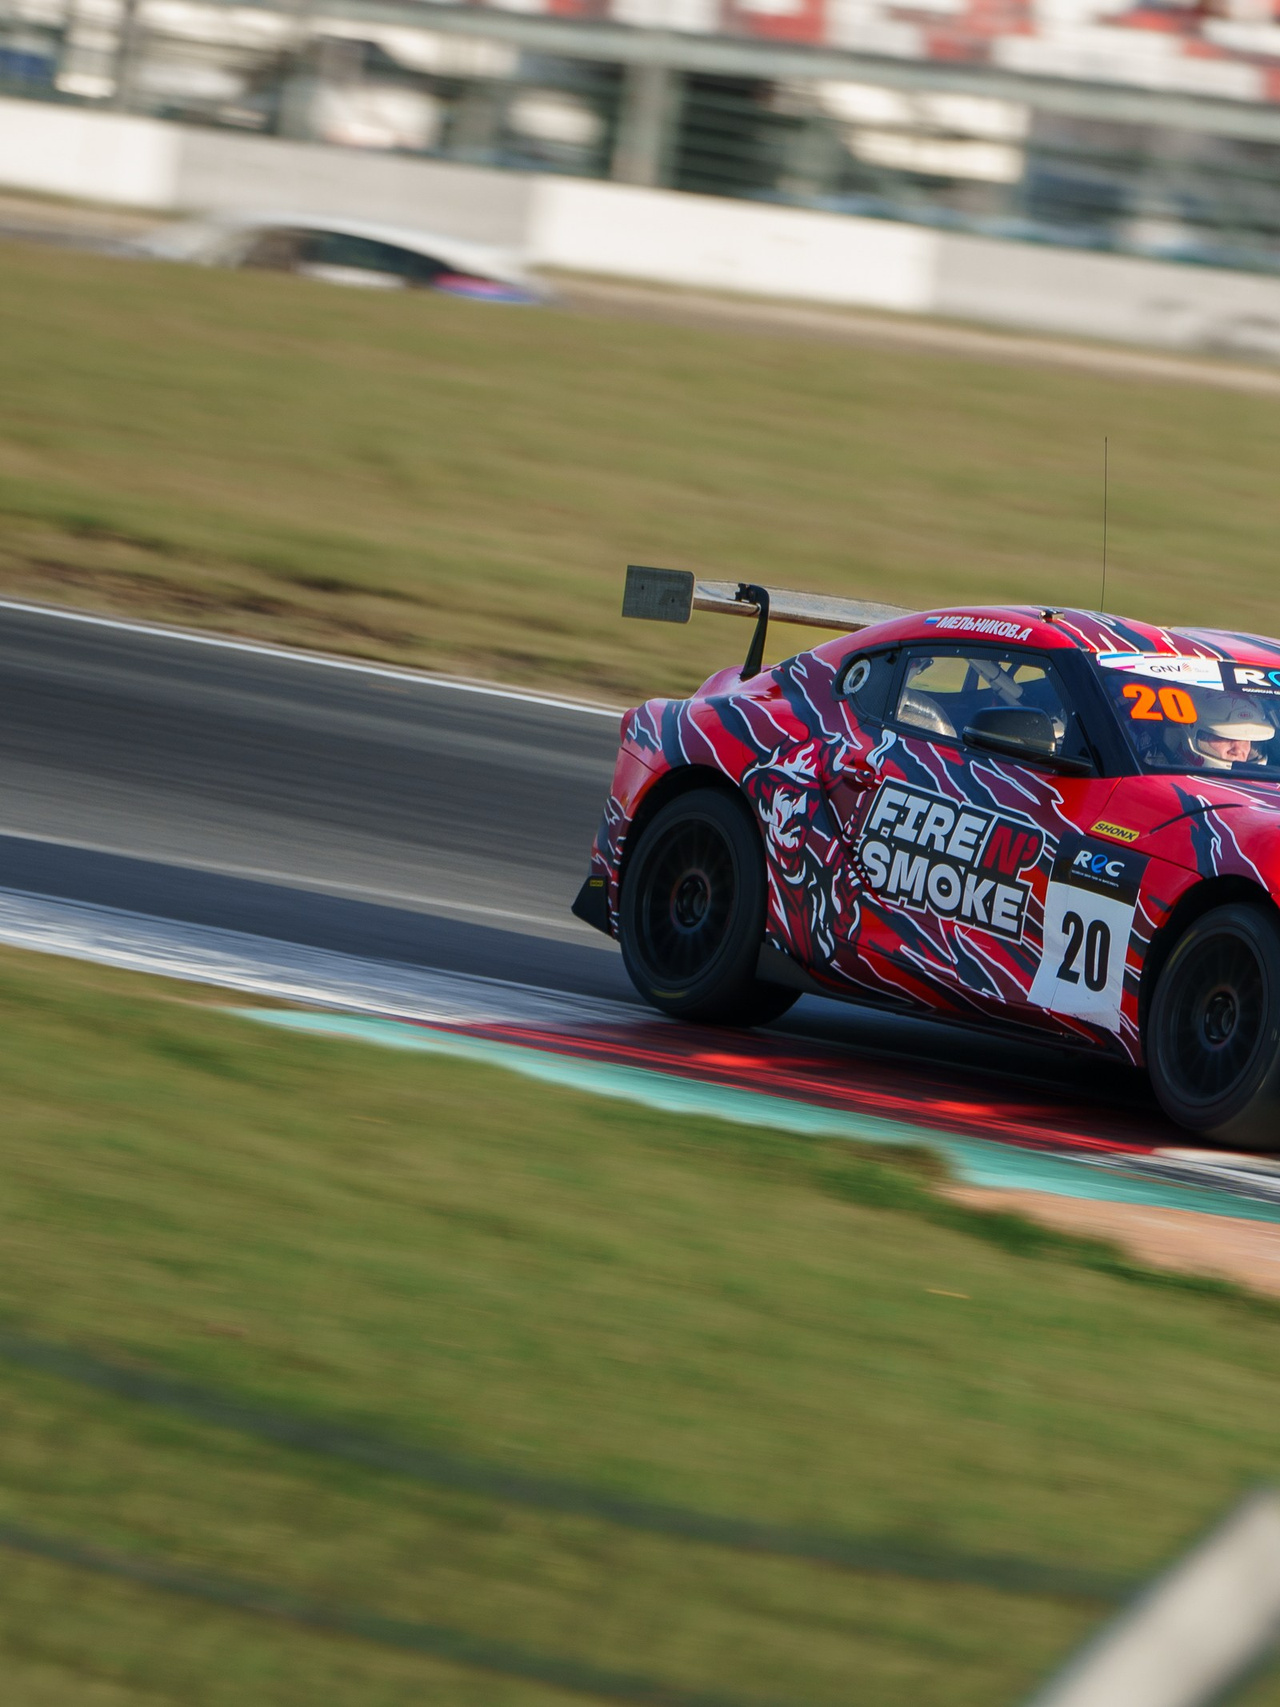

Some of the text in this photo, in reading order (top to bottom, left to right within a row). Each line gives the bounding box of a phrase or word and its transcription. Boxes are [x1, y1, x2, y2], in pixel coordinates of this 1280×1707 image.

[936, 616, 1033, 641] МЕЛЬНИКОВ.А
[1122, 683, 1198, 724] 20
[868, 787, 988, 862] FIRE
[1095, 822, 1137, 841] SHONX
[862, 841, 1025, 934] SMOKE
[1056, 910, 1111, 992] 20
